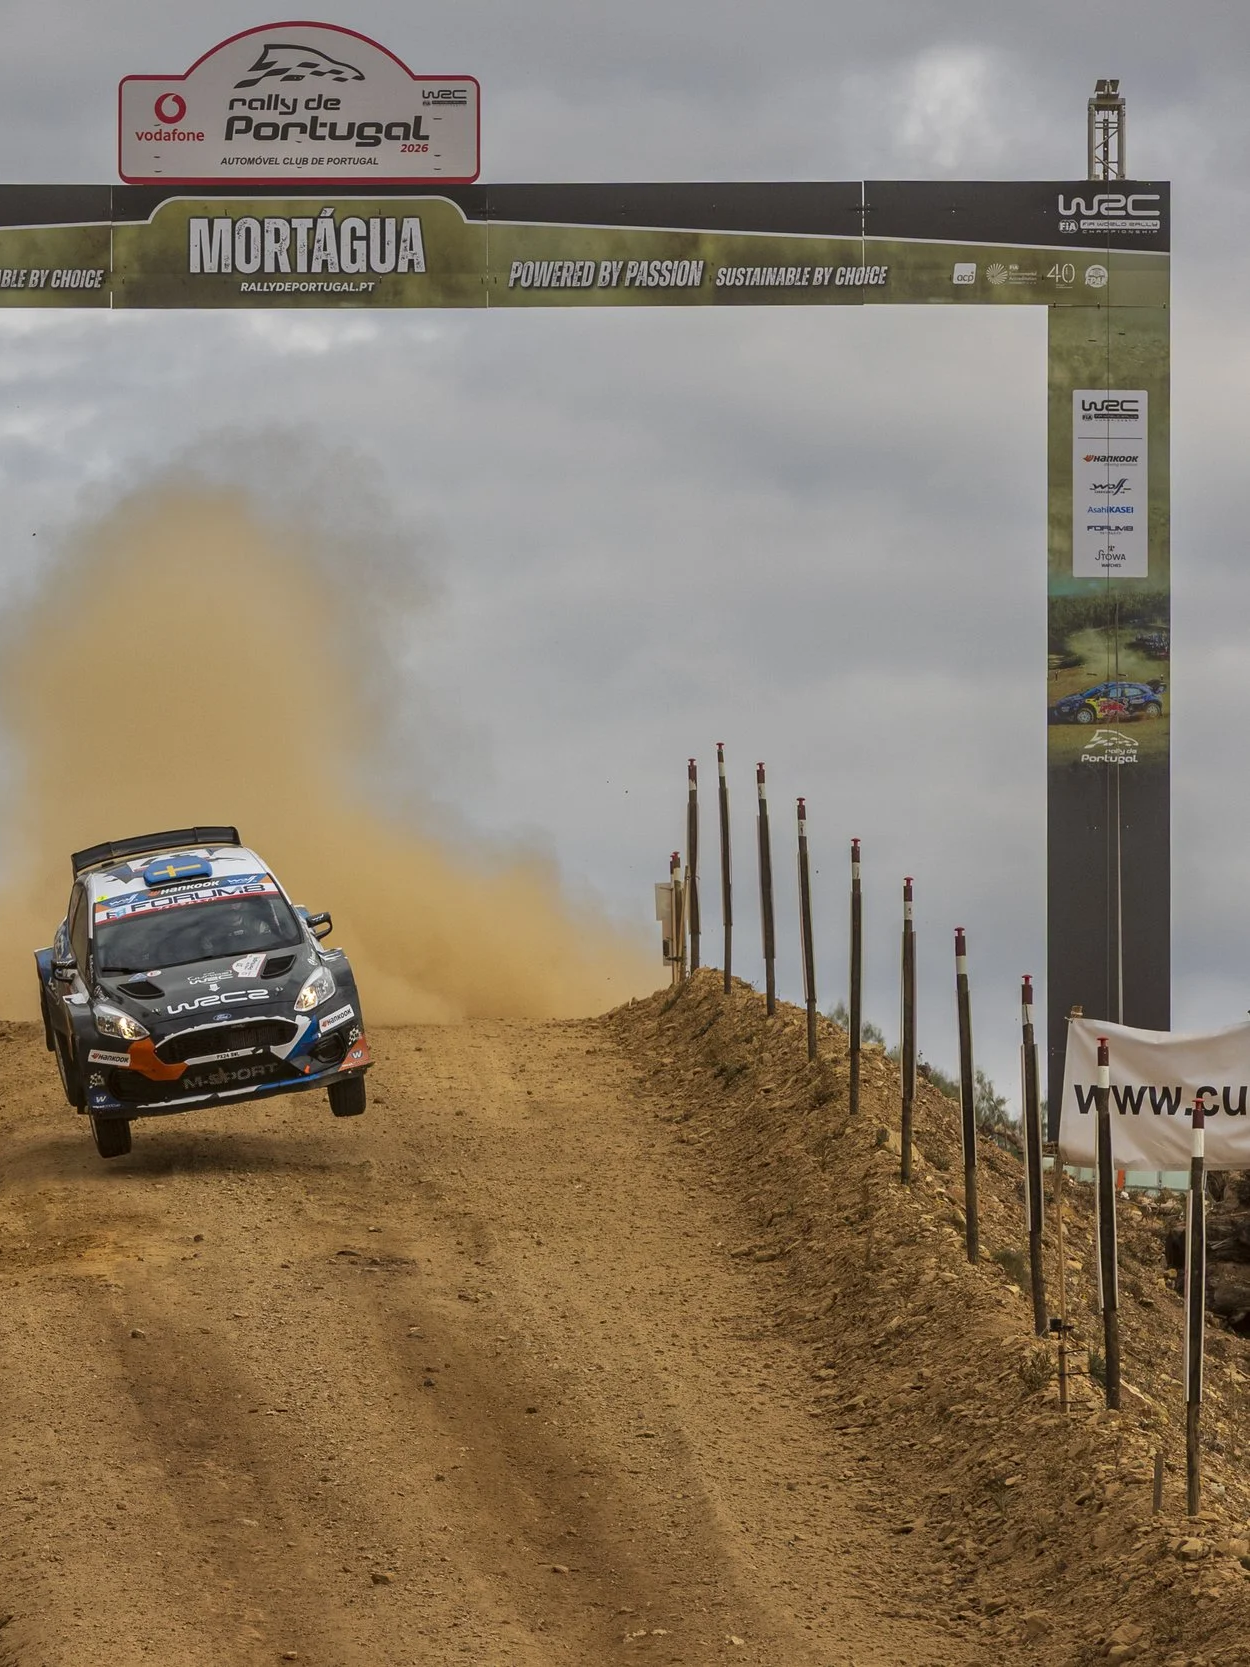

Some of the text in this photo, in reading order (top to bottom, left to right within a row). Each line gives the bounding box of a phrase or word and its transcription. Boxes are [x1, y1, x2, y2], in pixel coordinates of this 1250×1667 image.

[229, 93, 341, 115] rally de
[422, 90, 467, 100] WRC
[135, 129, 205, 142] vodafone
[225, 115, 430, 147] Portugal
[400, 143, 429, 153] 2026
[220, 155, 379, 166] AUTOMÓVEL CLUB DE PORTUGAL
[1058, 194, 1160, 216] WRC
[1059, 222, 1077, 231] FIA
[189, 207, 426, 274] MORTÁGUA
[28, 269, 49, 288] BY
[50, 269, 104, 288] CHOICE
[508, 260, 704, 287] POWERED BY PASSION
[716, 266, 888, 286] SUSTAINABLE BY CHOICE
[1046, 263, 1076, 284] 40
[240, 282, 375, 292] RALLYDEPORTUGAL.PT
[1081, 399, 1139, 412] WRC
[1081, 754, 1138, 764] Portugal
[131, 884, 265, 912] FORUM8
[167, 989, 269, 1015] WRC2
[183, 1062, 278, 1089] M-SPORT
